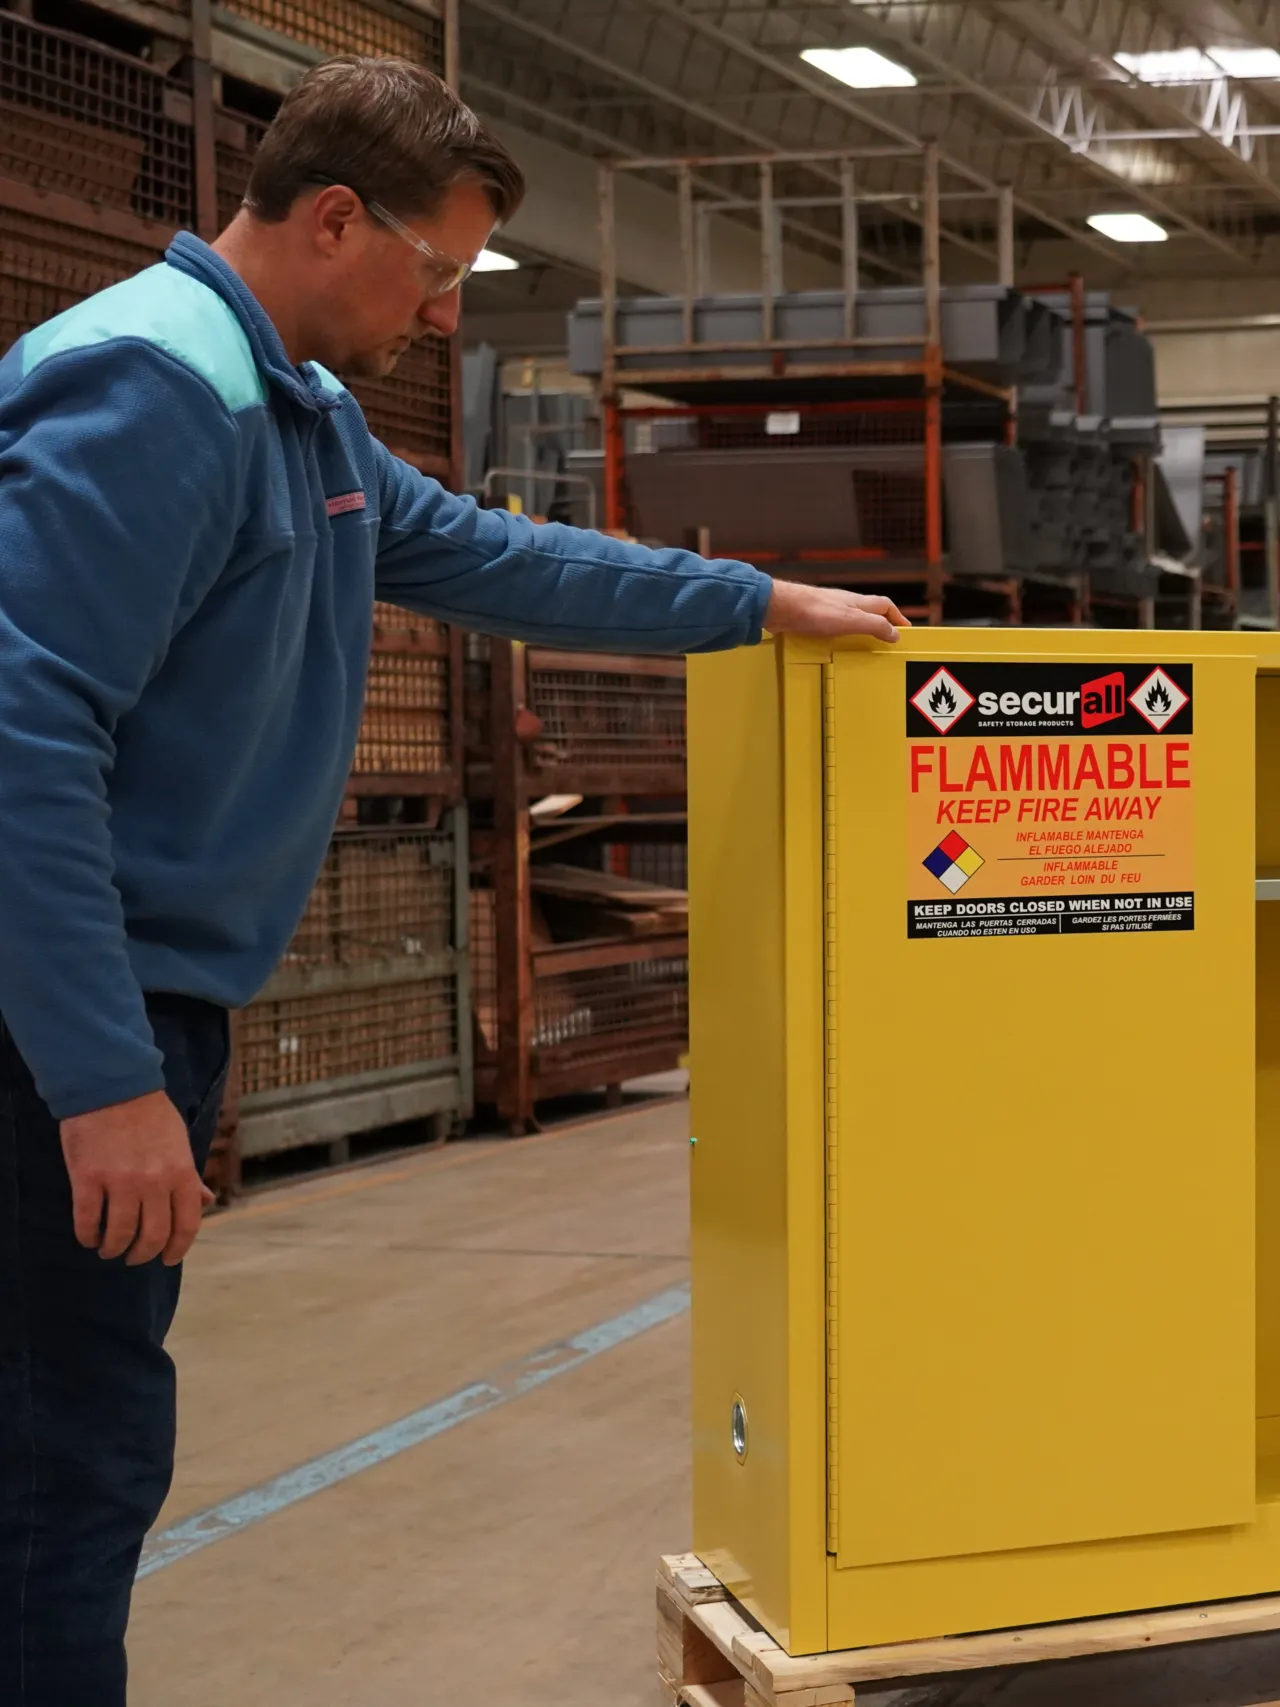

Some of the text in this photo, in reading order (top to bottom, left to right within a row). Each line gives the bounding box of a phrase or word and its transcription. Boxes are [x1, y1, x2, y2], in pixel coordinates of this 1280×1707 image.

[978, 685, 1122, 715] securall
[911, 743, 1191, 793] FLAMMABLE
[936, 796, 1162, 824] KEEP FIRE AWAY
[1016, 830, 1144, 842] INFLAMABLE MANTENGA
[1029, 843, 1132, 856] EL FUEGO ALEJADO
[1043, 860, 1119, 872] INFLAMMABLE
[1020, 873, 1141, 886] GARDER LOIN DU FEU
[914, 897, 1192, 916] KEEP DOORS CLOSED WHEN NOT IN USE
[916, 922, 958, 930] MANTENGA
[1016, 918, 1057, 926] CERRADAS
[1072, 916, 1102, 924] GARDEZ
[1148, 912, 1182, 921] FERMÉES
[937, 929, 969, 937] CUANDO
